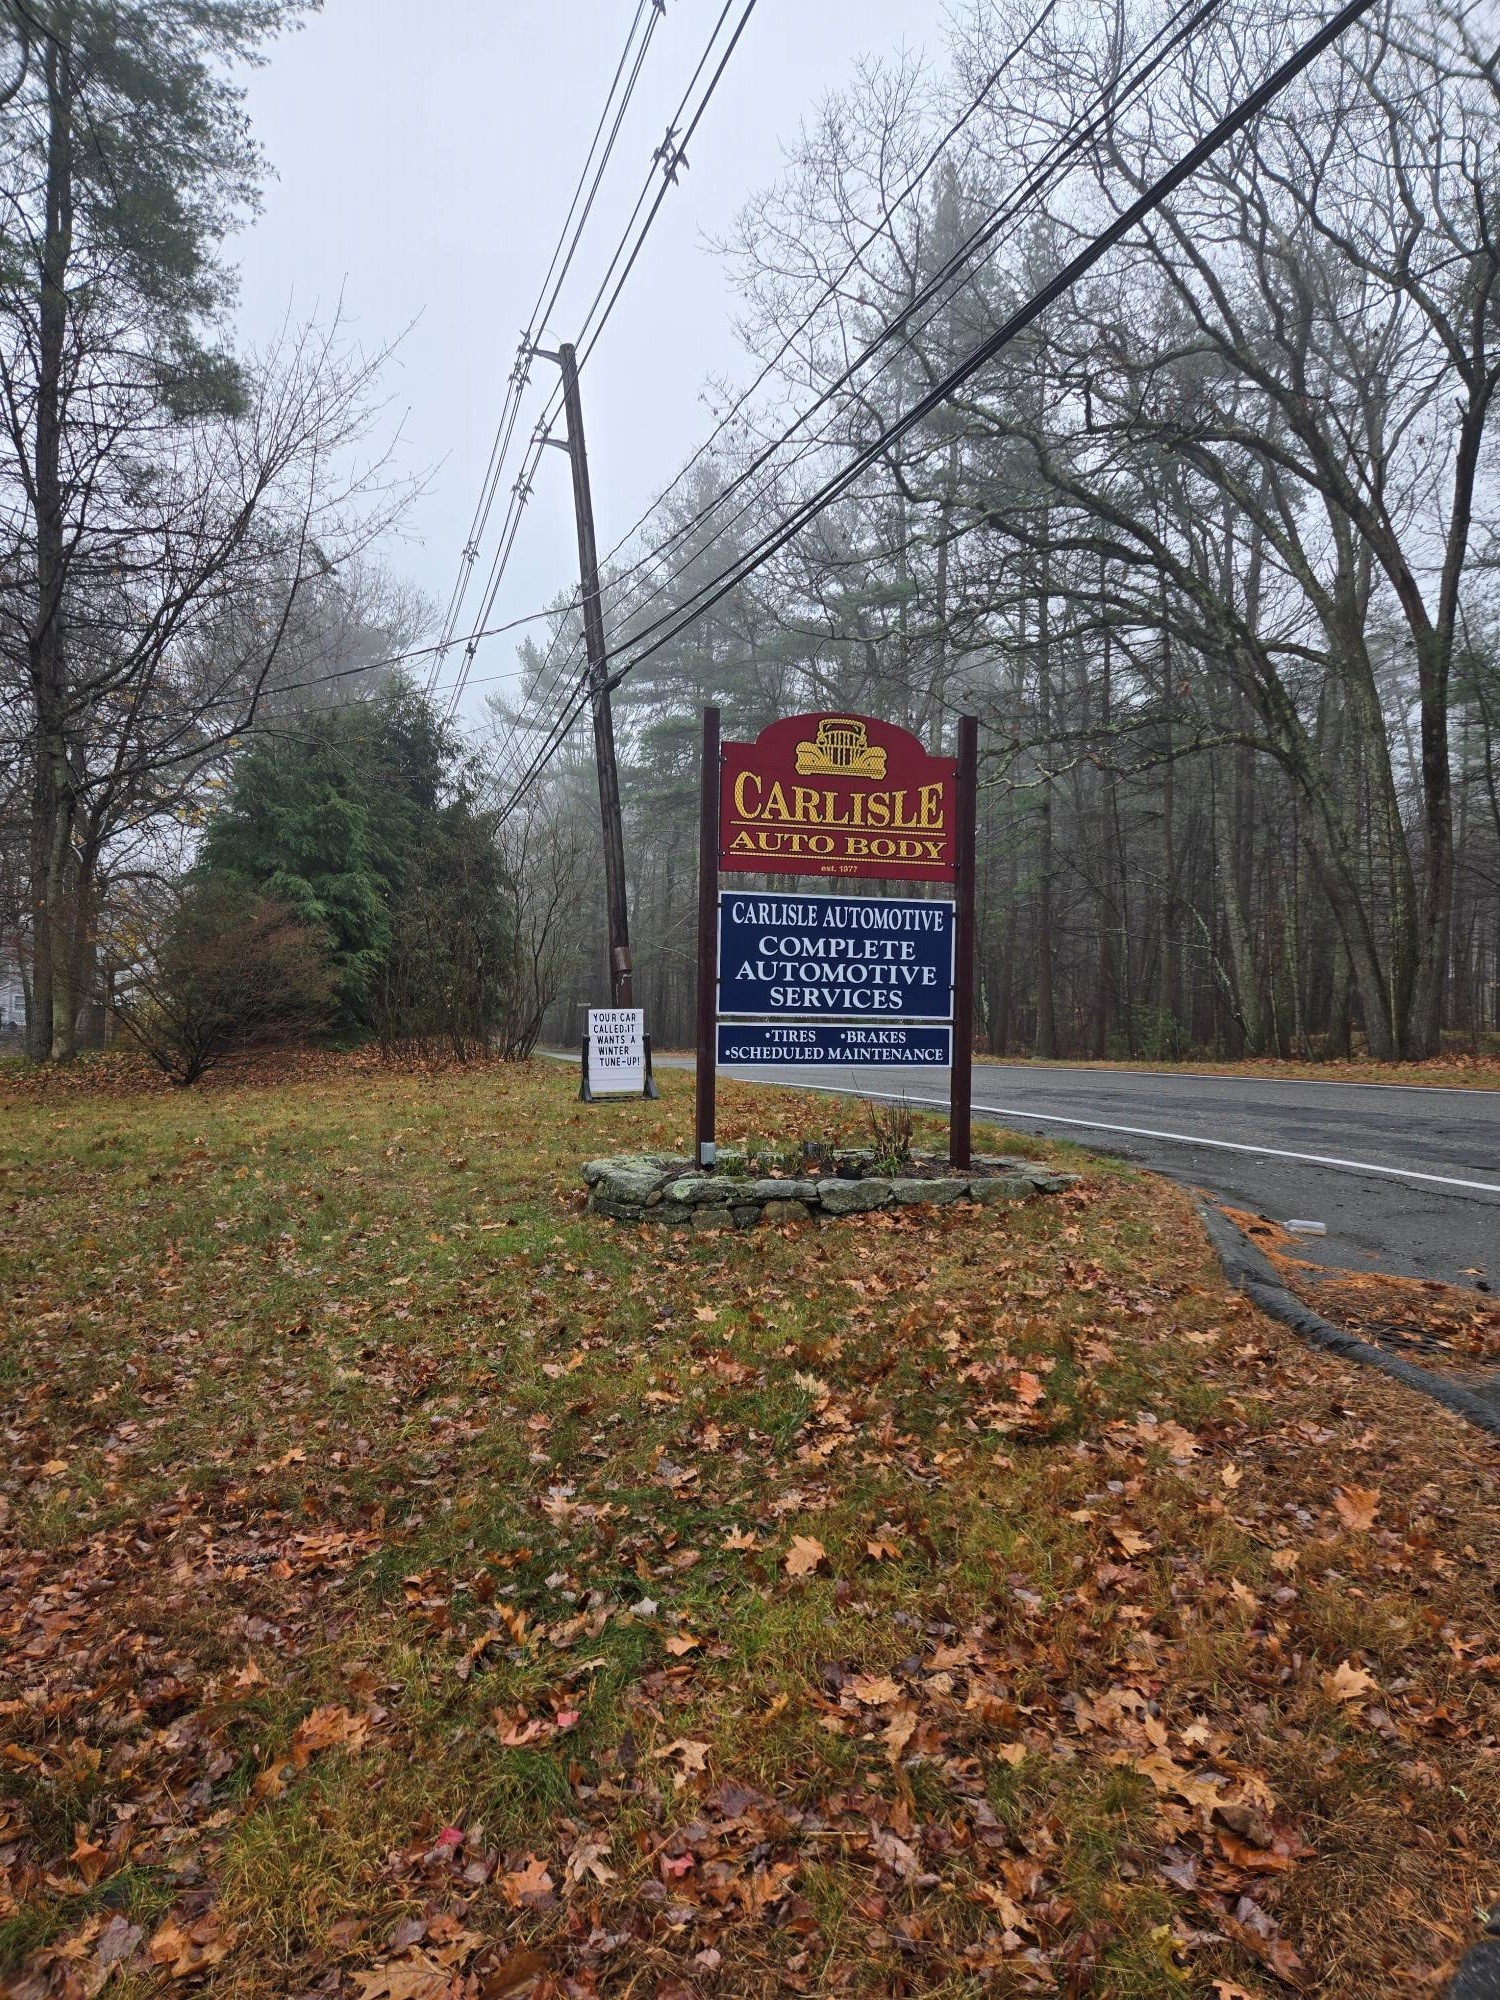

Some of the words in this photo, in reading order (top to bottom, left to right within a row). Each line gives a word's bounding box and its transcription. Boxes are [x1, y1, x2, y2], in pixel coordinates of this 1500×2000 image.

[734, 771, 944, 829] CARLISLE
[729, 830, 835, 853] AUTO
[844, 837, 947, 859] BODY
[732, 901, 818, 927] CARLISLE
[823, 905, 944, 932] AUTOMOTIVE
[758, 936, 916, 961] COMPLETE
[734, 960, 937, 986] AUTOMOTIVE
[769, 987, 902, 1009] SERVICES
[593, 1013, 617, 1022] YOUR
[619, 1013, 636, 1022] CAR
[596, 1035, 626, 1045] WANTS
[630, 1035, 636, 1044] A
[598, 1046, 629, 1056] WINTER
[600, 1057, 640, 1067] TUNE-UP!
[828, 1047, 944, 1061] MAINTENANCE
